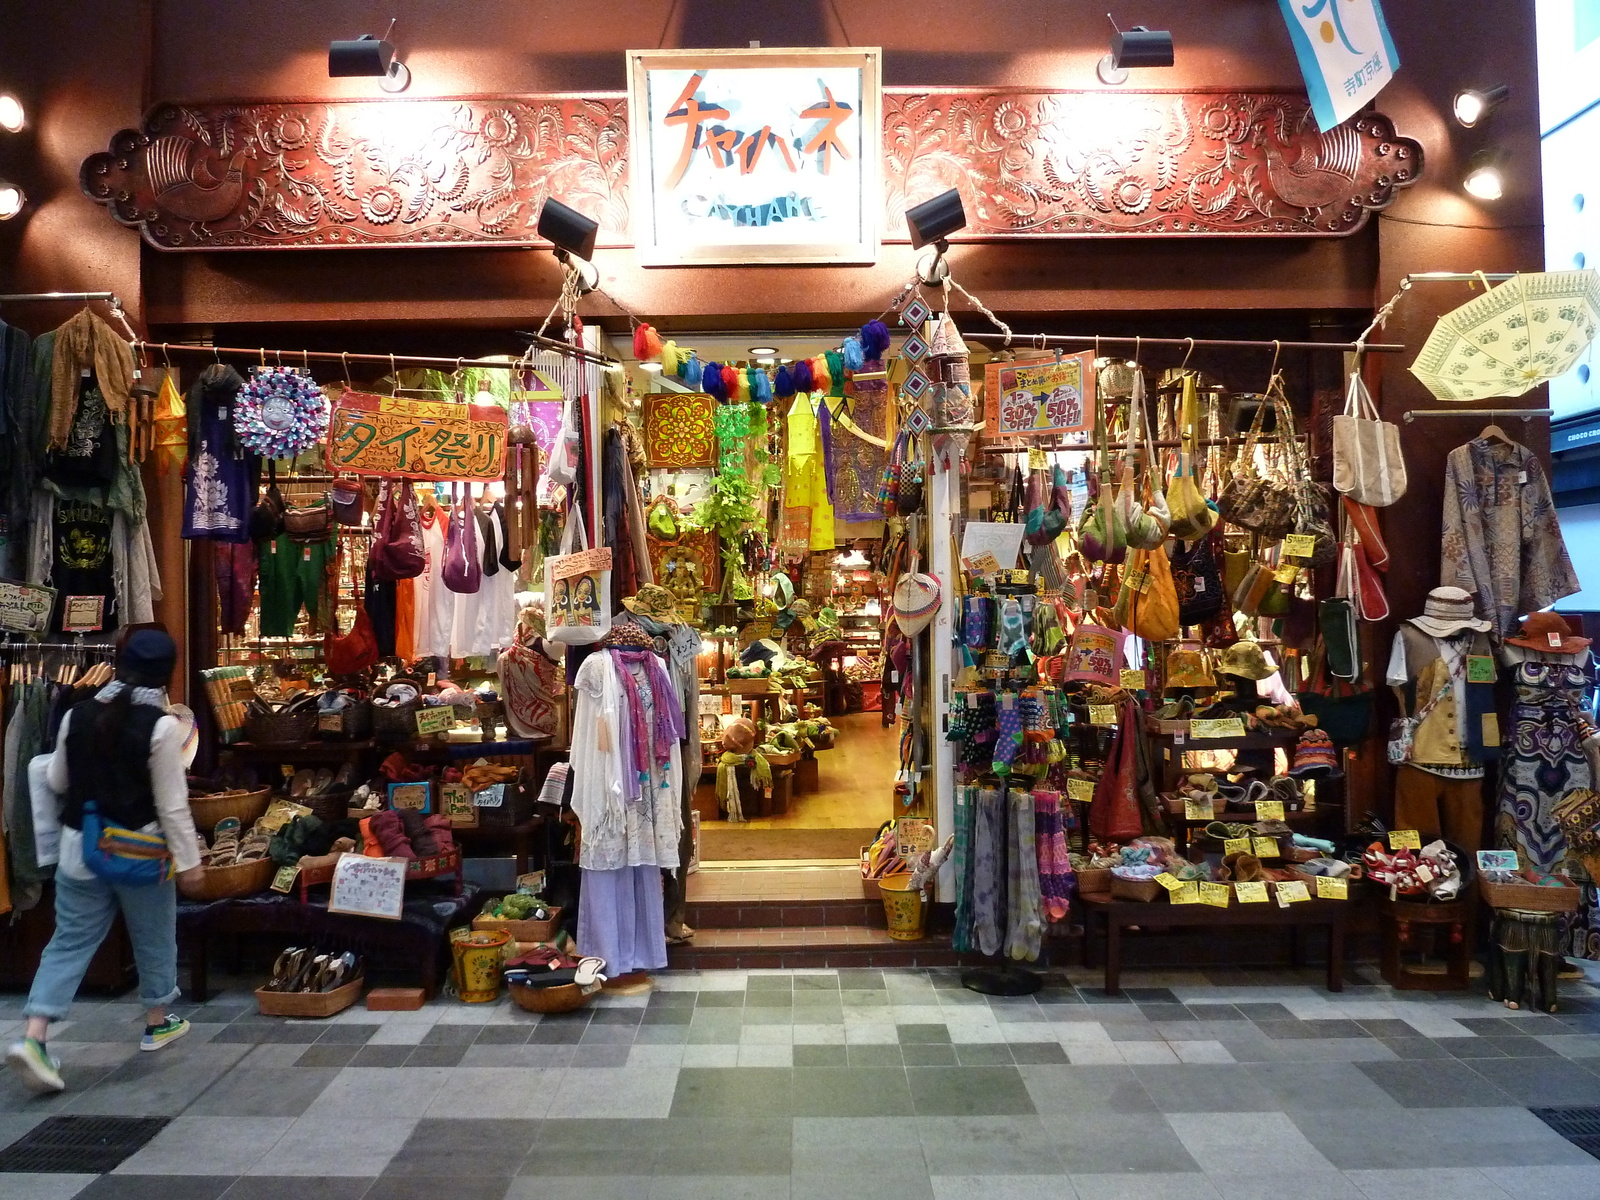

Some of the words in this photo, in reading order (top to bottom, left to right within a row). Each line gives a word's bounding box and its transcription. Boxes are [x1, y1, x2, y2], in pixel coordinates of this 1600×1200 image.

[1003, 402, 1038, 422] 30%
[1046, 398, 1078, 419] 50%
[367, 415, 418, 426] Thailand
[1009, 417, 1034, 430] OFF!
[1053, 410, 1080, 427] OFF!!
[1567, 431, 1588, 442] CHOCO
[338, 423, 495, 473] タイ祭り
[444, 790, 467, 803] Thai
